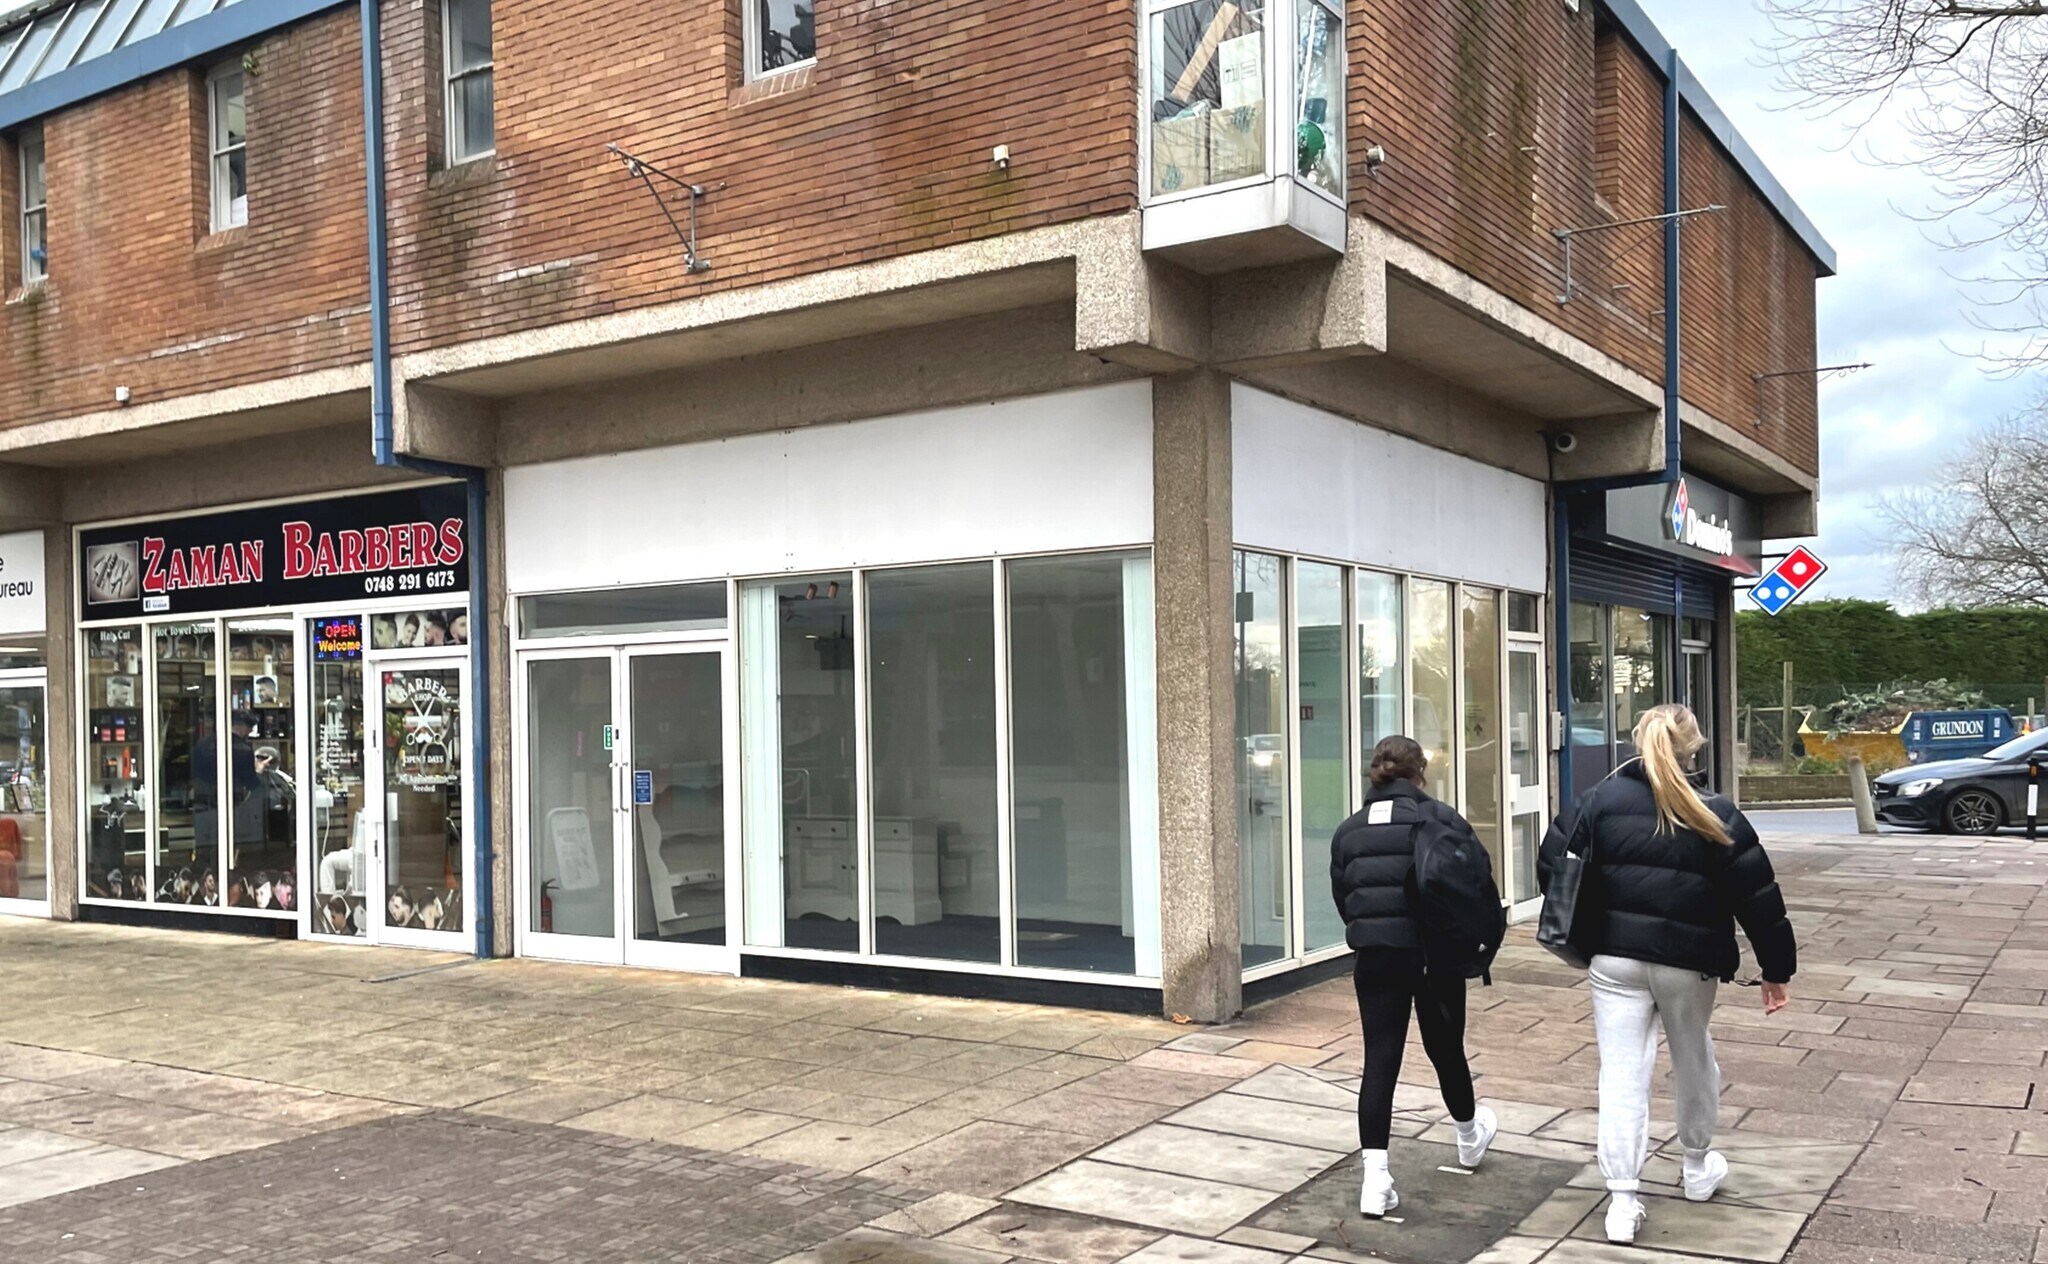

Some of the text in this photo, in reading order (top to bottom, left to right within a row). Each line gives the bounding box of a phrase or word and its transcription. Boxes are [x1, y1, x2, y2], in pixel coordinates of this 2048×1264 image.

[1686, 507, 1733, 557] Domino's
[364, 570, 455, 593] 0748 291 6173
[325, 624, 356, 638] OPEN
[318, 640, 361, 652] Welcome
[414, 692, 432, 702] SHOP
[1932, 720, 1984, 736] GRUNDON
[427, 755, 444, 763] DAYS
[412, 784, 436, 792] Needed
